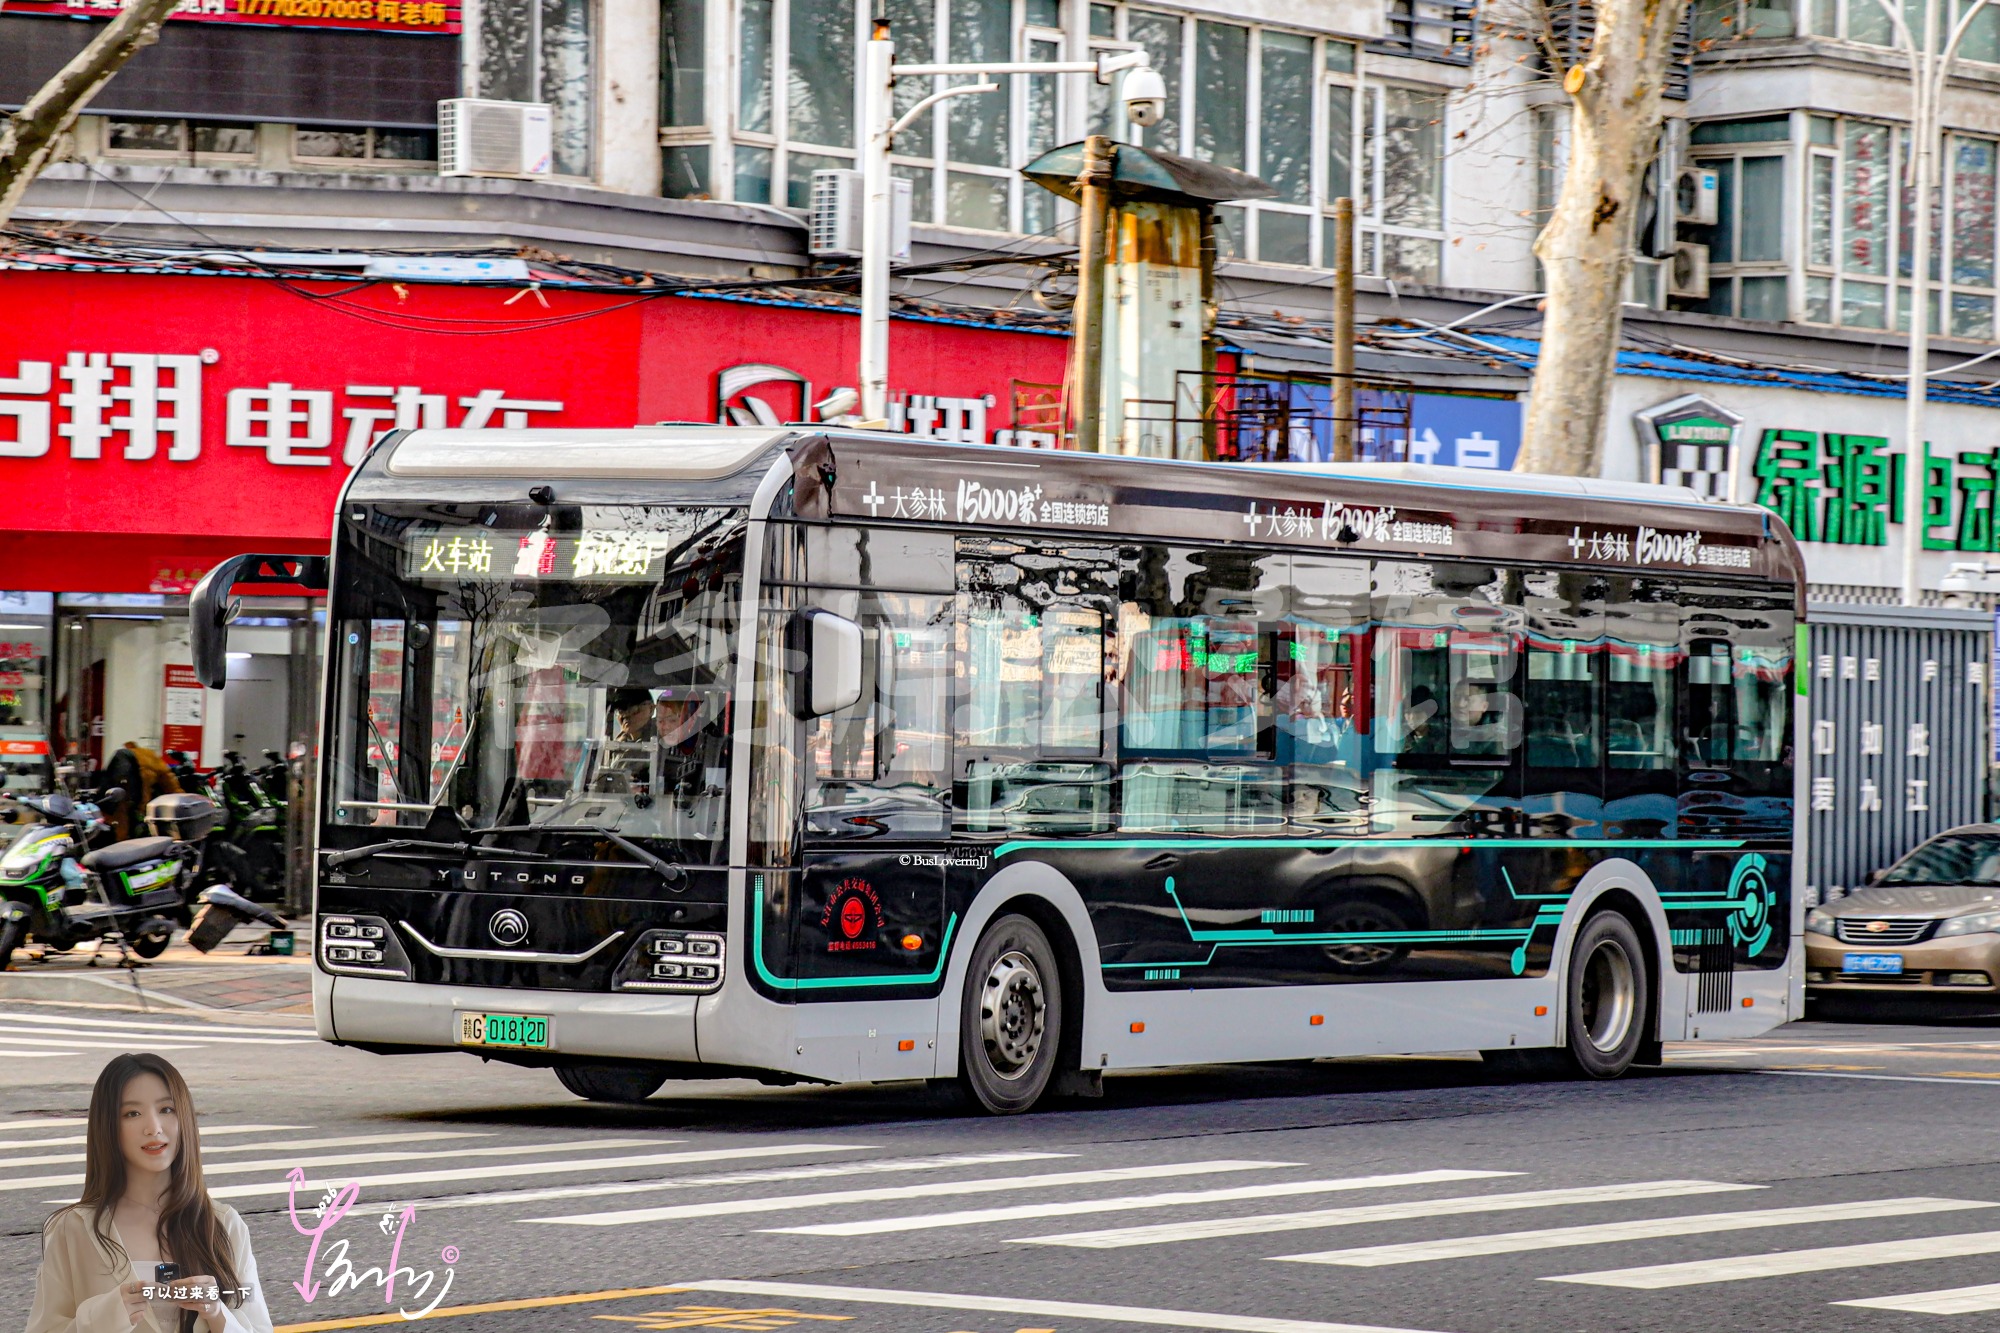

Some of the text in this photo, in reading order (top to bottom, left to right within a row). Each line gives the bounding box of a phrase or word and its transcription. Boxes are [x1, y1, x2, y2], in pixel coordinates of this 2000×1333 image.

[890, 486, 947, 521] 大参林
[1040, 501, 1109, 527] 全国连锁药店
[1266, 506, 1314, 538] 大参林
[1392, 521, 1453, 545] 全国连锁药店
[421, 537, 493, 574] 火车站
[1588, 531, 1630, 562] 大参林
[1698, 546, 1751, 568] 全国连锁药店
[438, 870, 585, 884] YUTONG
